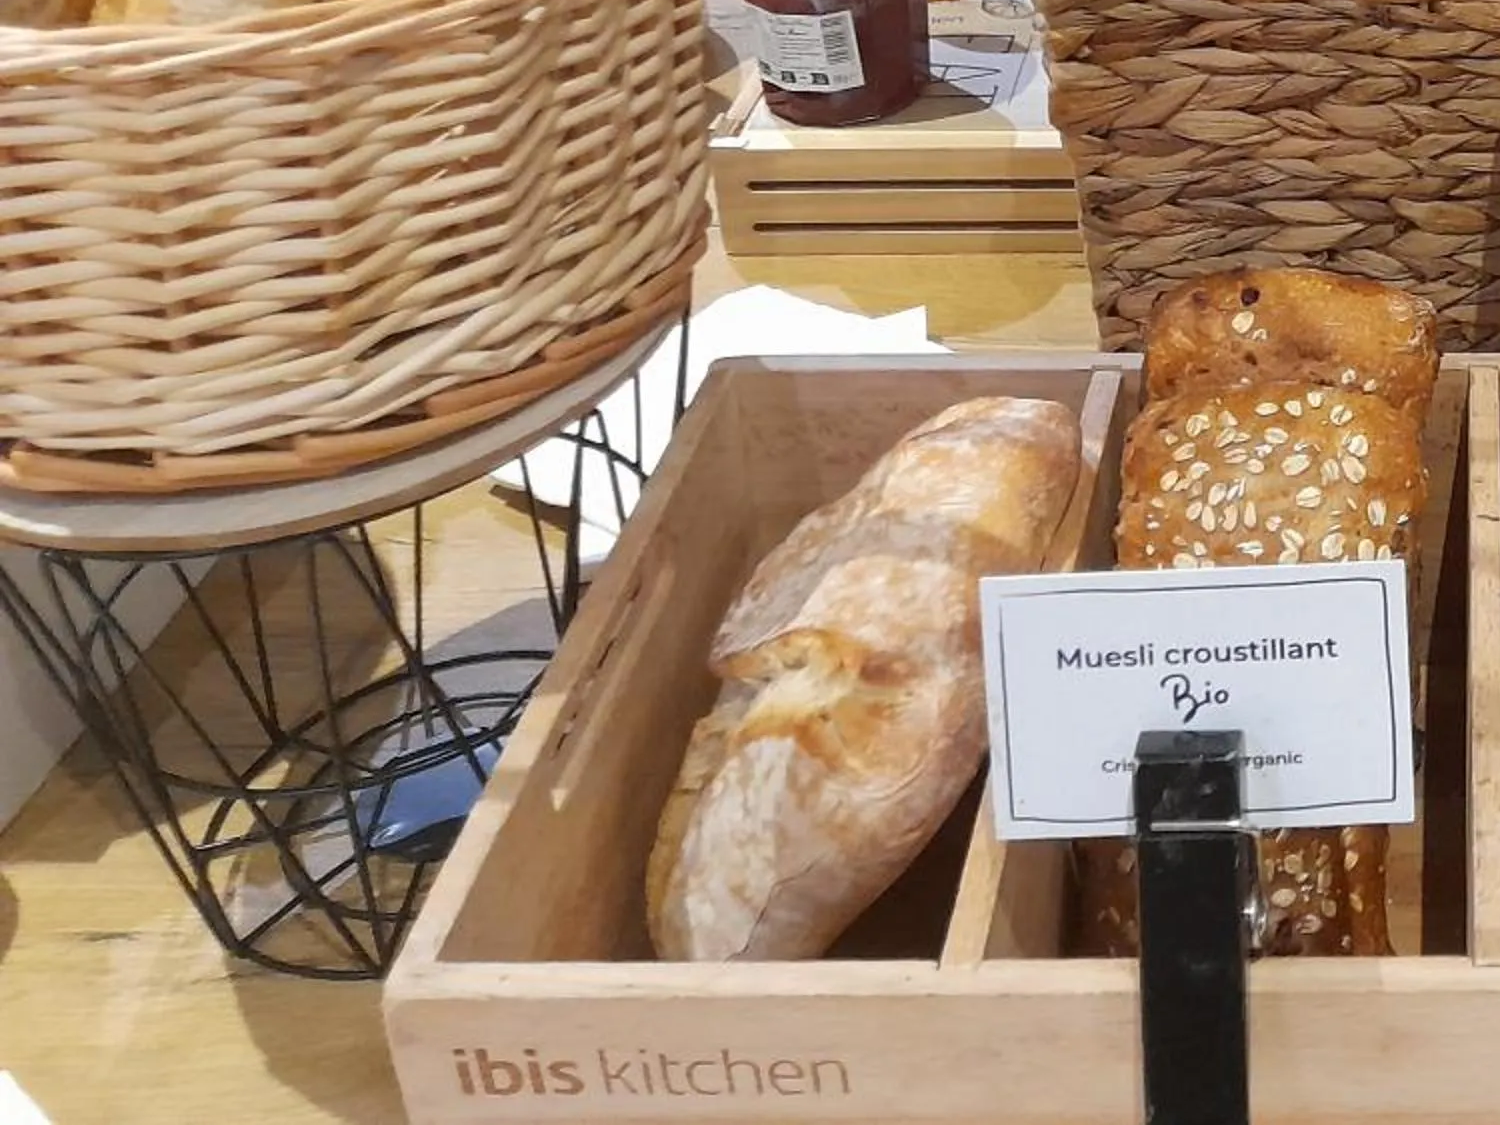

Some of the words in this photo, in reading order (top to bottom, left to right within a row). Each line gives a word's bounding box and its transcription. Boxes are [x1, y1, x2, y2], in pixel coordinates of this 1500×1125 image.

[1056, 643, 1155, 670] Muesli
[1164, 637, 1340, 665] croustillant
[1160, 673, 1230, 724] Bio
[1241, 749, 1303, 770] rganic
[452, 1048, 586, 1096] ibis
[597, 1048, 851, 1096] kitchen
